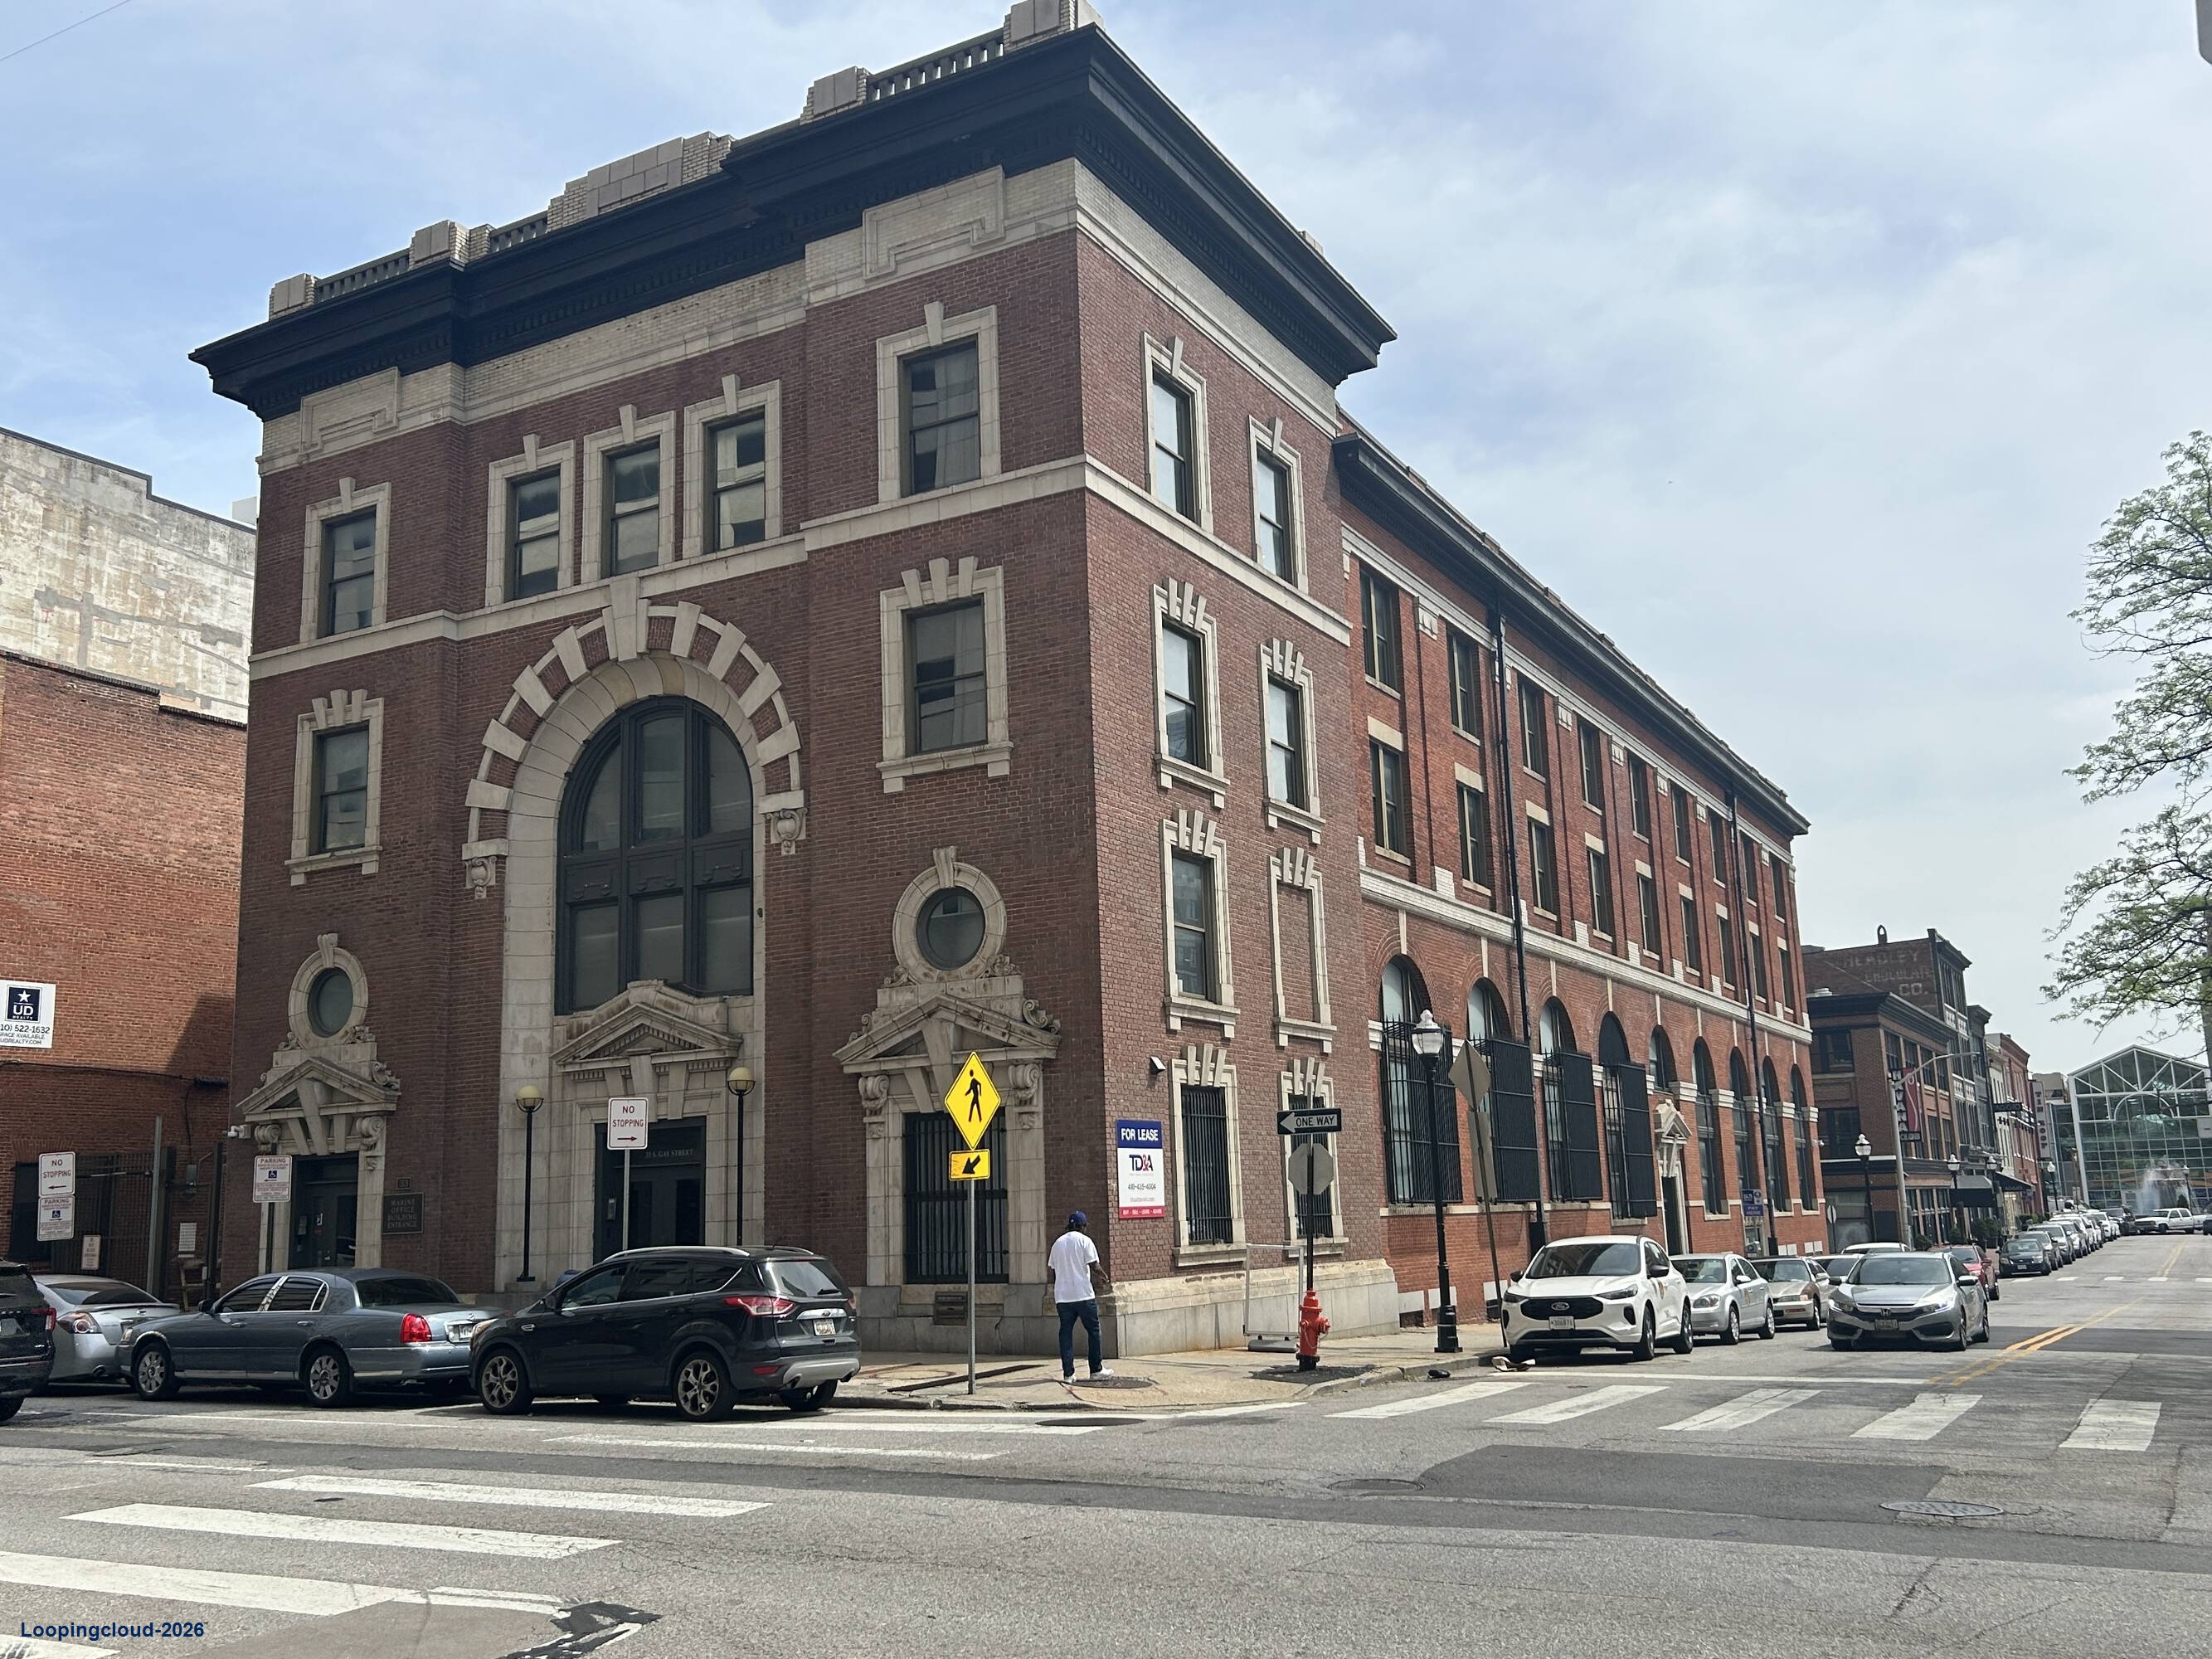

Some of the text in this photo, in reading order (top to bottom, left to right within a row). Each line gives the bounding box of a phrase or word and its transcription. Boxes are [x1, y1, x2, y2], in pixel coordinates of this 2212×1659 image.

[1899, 982, 1928, 995] CO.
[13, 1005, 34, 1016] UD
[15, 1024, 51, 1034] 522-1632
[622, 1105, 634, 1114] NO
[612, 1119, 644, 1128] STOPPING
[1296, 1115, 1334, 1127] ONE WAY
[1121, 1128, 1159, 1141] FOR LEASE
[1129, 1154, 1154, 1171] TD&A
[43, 1170, 71, 1179] STOPPING
